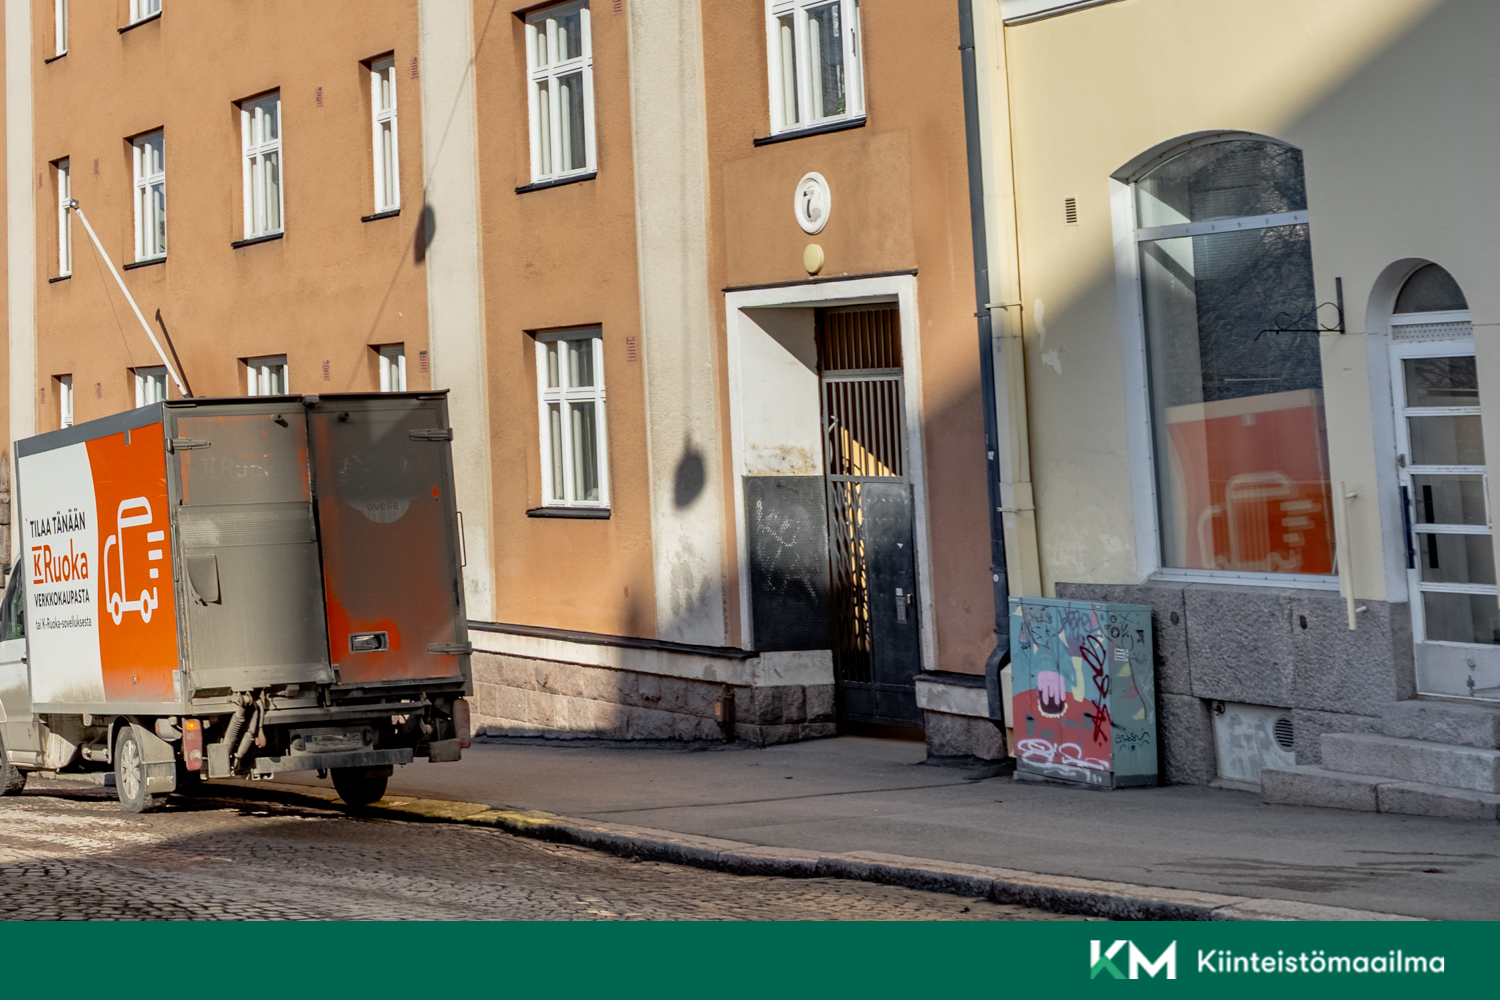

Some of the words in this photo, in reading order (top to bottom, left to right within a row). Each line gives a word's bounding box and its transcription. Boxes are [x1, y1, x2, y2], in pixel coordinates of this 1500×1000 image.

[29, 518, 52, 538] TILAA
[52, 507, 86, 534] TÄNÄÄN
[34, 589, 91, 608] VERKKOKAUPASTA
